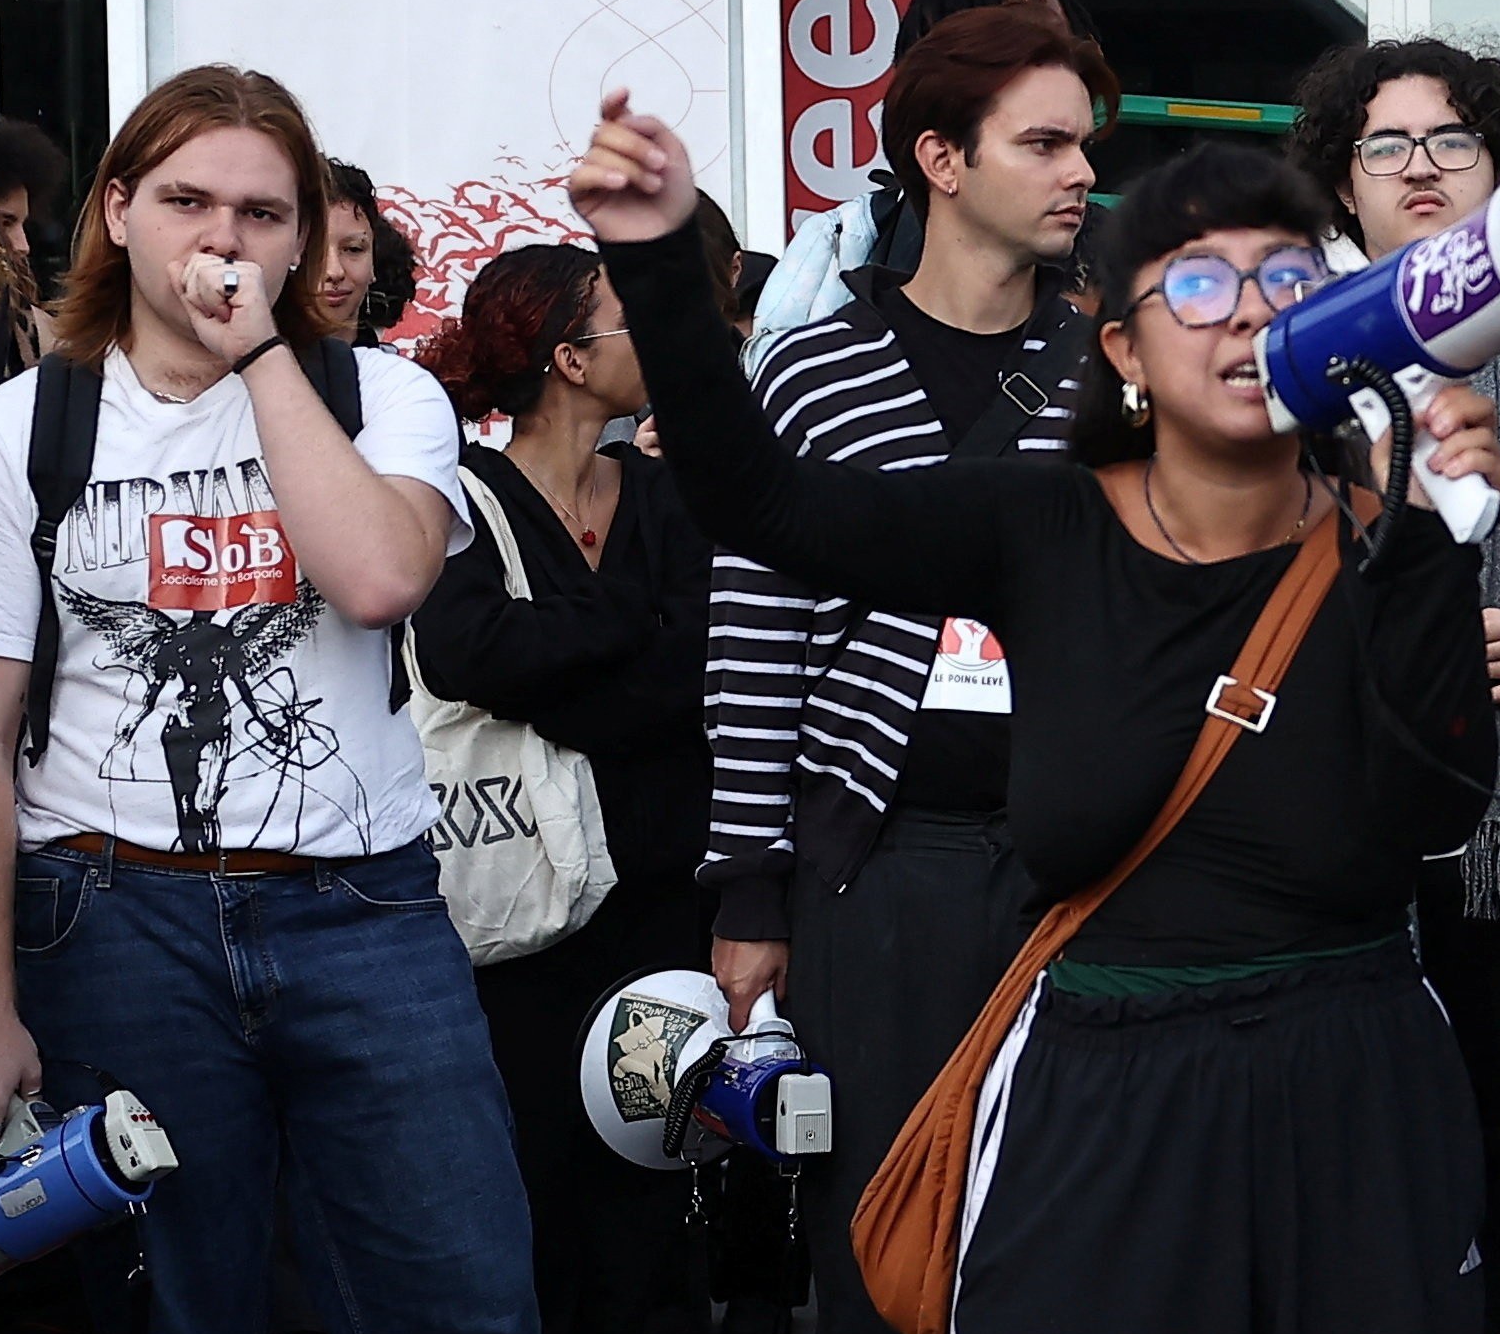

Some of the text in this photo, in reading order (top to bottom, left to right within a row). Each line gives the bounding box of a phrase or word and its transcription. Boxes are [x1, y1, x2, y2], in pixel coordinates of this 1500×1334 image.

[161, 568, 283, 587] Socialisme ou Barbarie
[934, 673, 944, 683] LE
[948, 674, 978, 685] POING
